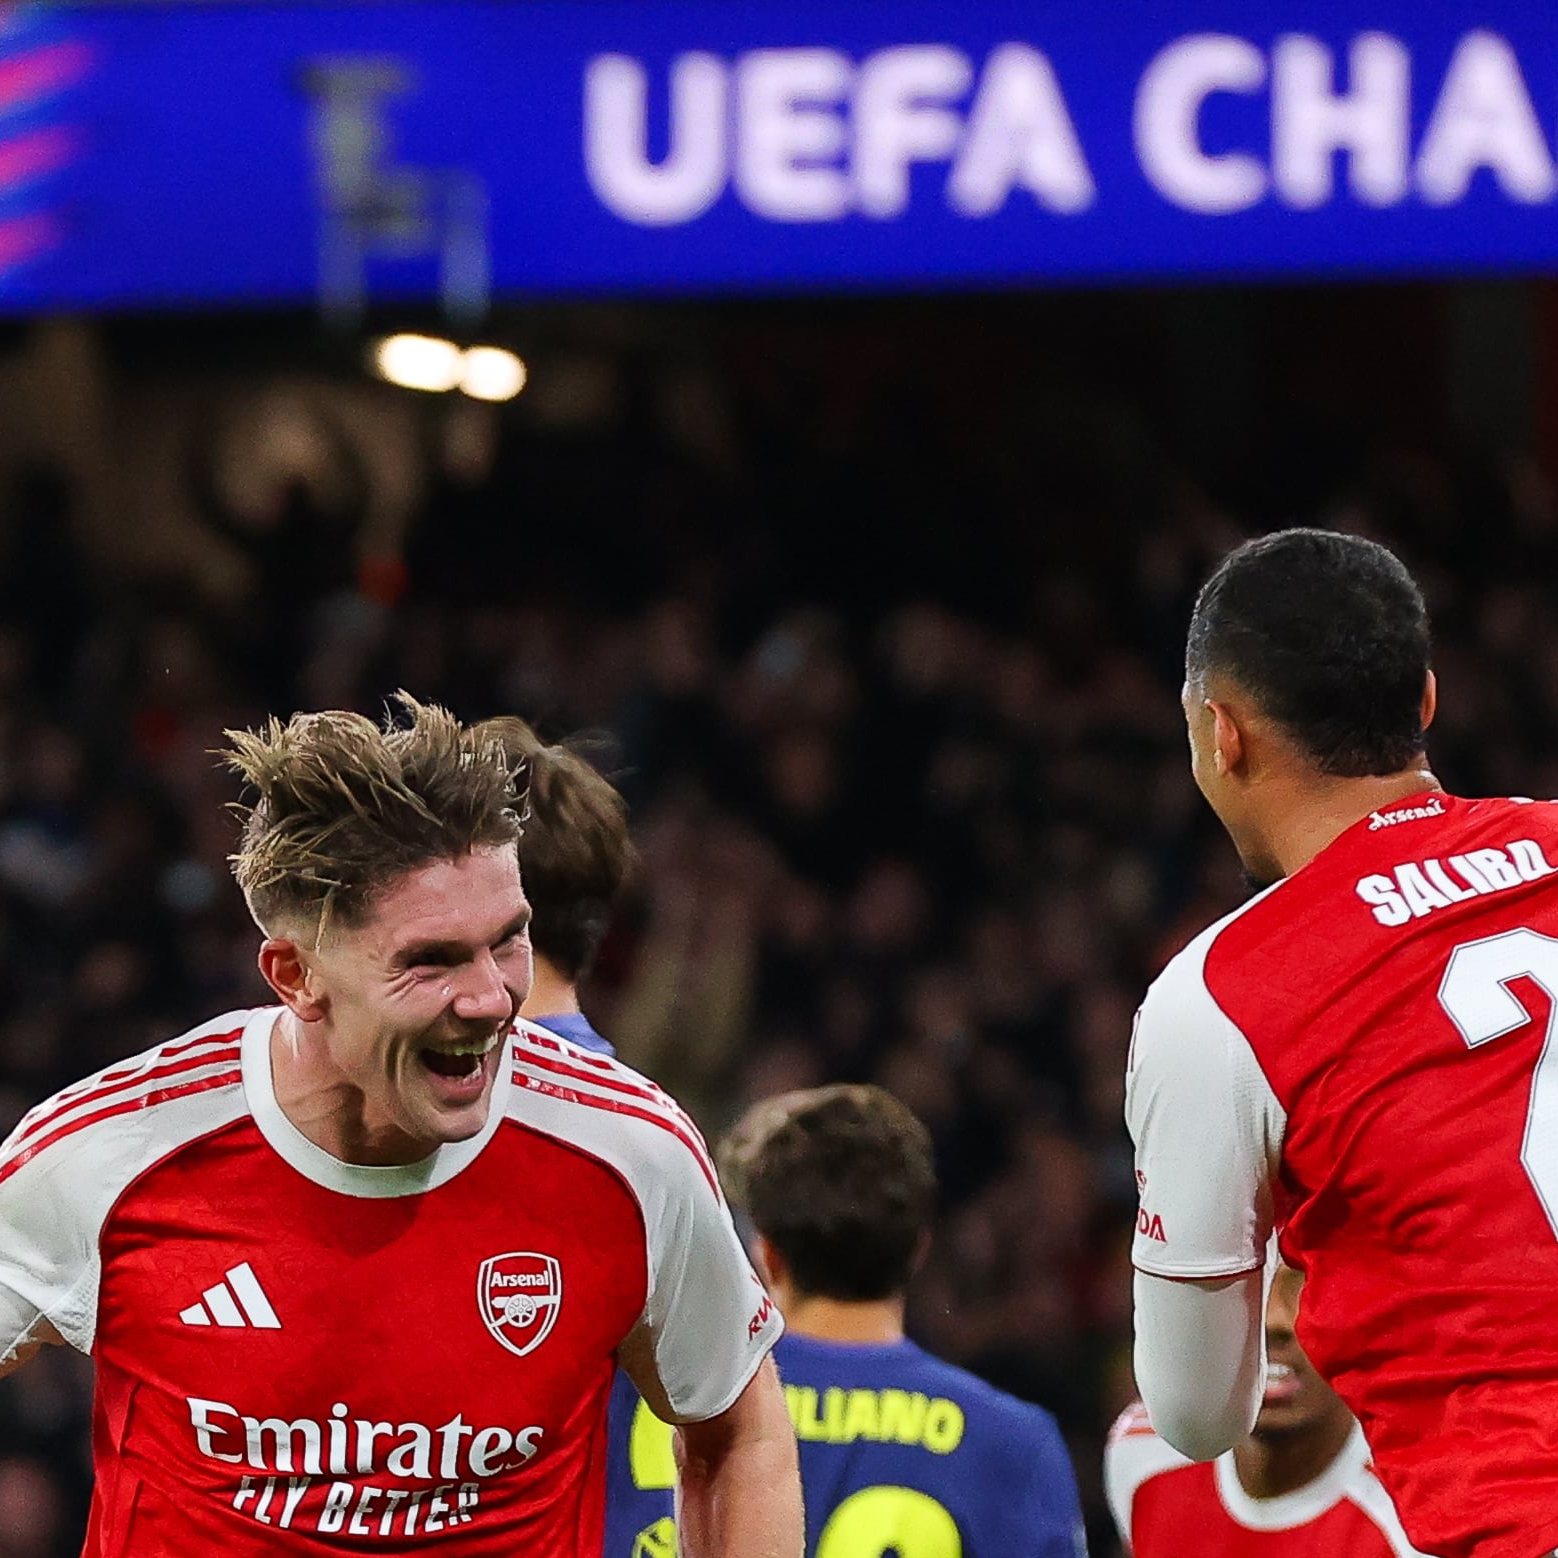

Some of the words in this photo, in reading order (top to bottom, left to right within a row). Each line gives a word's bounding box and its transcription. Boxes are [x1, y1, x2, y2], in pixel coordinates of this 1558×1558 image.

[583, 42, 1096, 227] UEFA
[1368, 798, 1446, 831] Arsenal
[490, 1271, 549, 1288] Arsenal
[186, 1397, 544, 1479] Emirates
[783, 1384, 966, 1455] LIANO
[233, 1476, 312, 1529] FLY
[317, 1482, 480, 1536] BETTER
